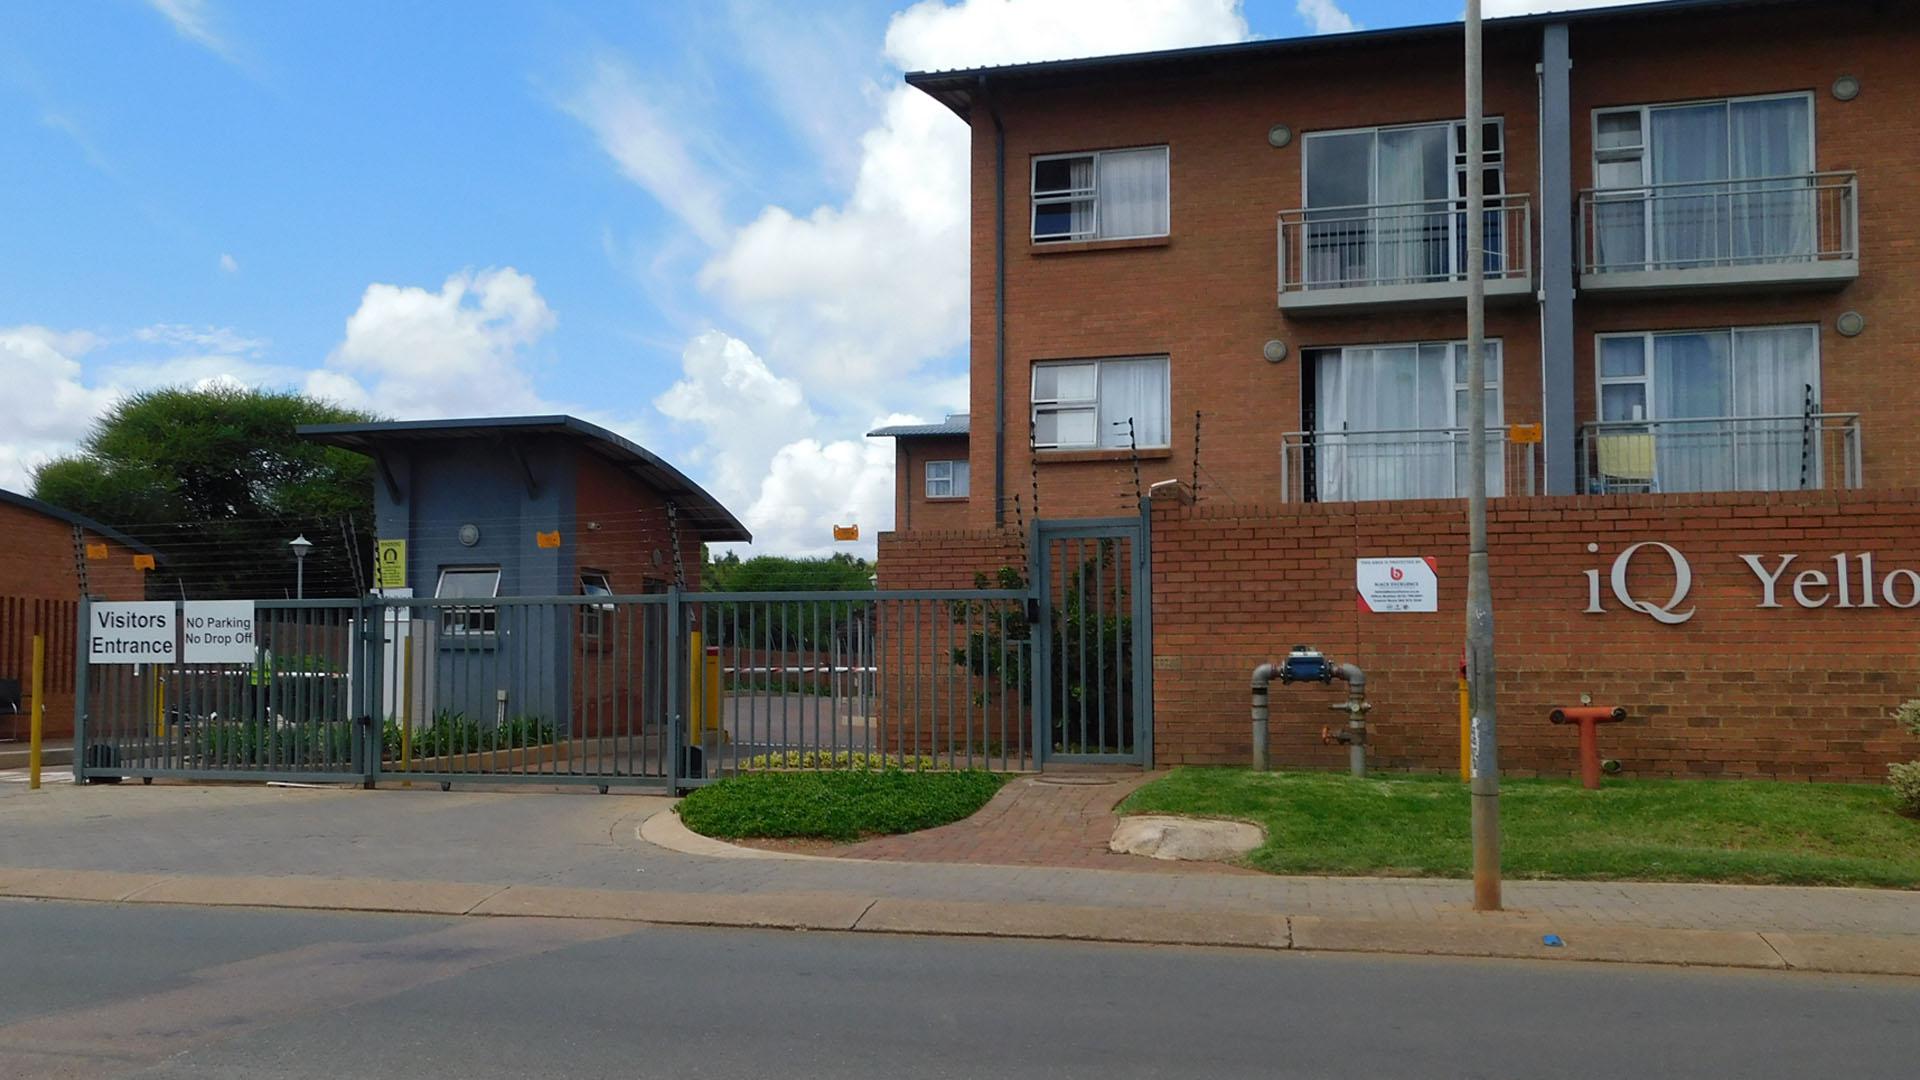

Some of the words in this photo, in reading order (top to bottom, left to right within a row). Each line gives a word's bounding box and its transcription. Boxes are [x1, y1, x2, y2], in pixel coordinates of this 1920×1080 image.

[1583, 541, 1696, 624] iQ
[1739, 551, 1920, 608] Yello
[98, 611, 166, 628] Visitors
[186, 617, 204, 628] NO
[207, 617, 251, 630] Parking
[92, 637, 173, 653] Entrance
[185, 633, 200, 643] No
[204, 633, 231, 646] Drop
[235, 632, 252, 643] Off
